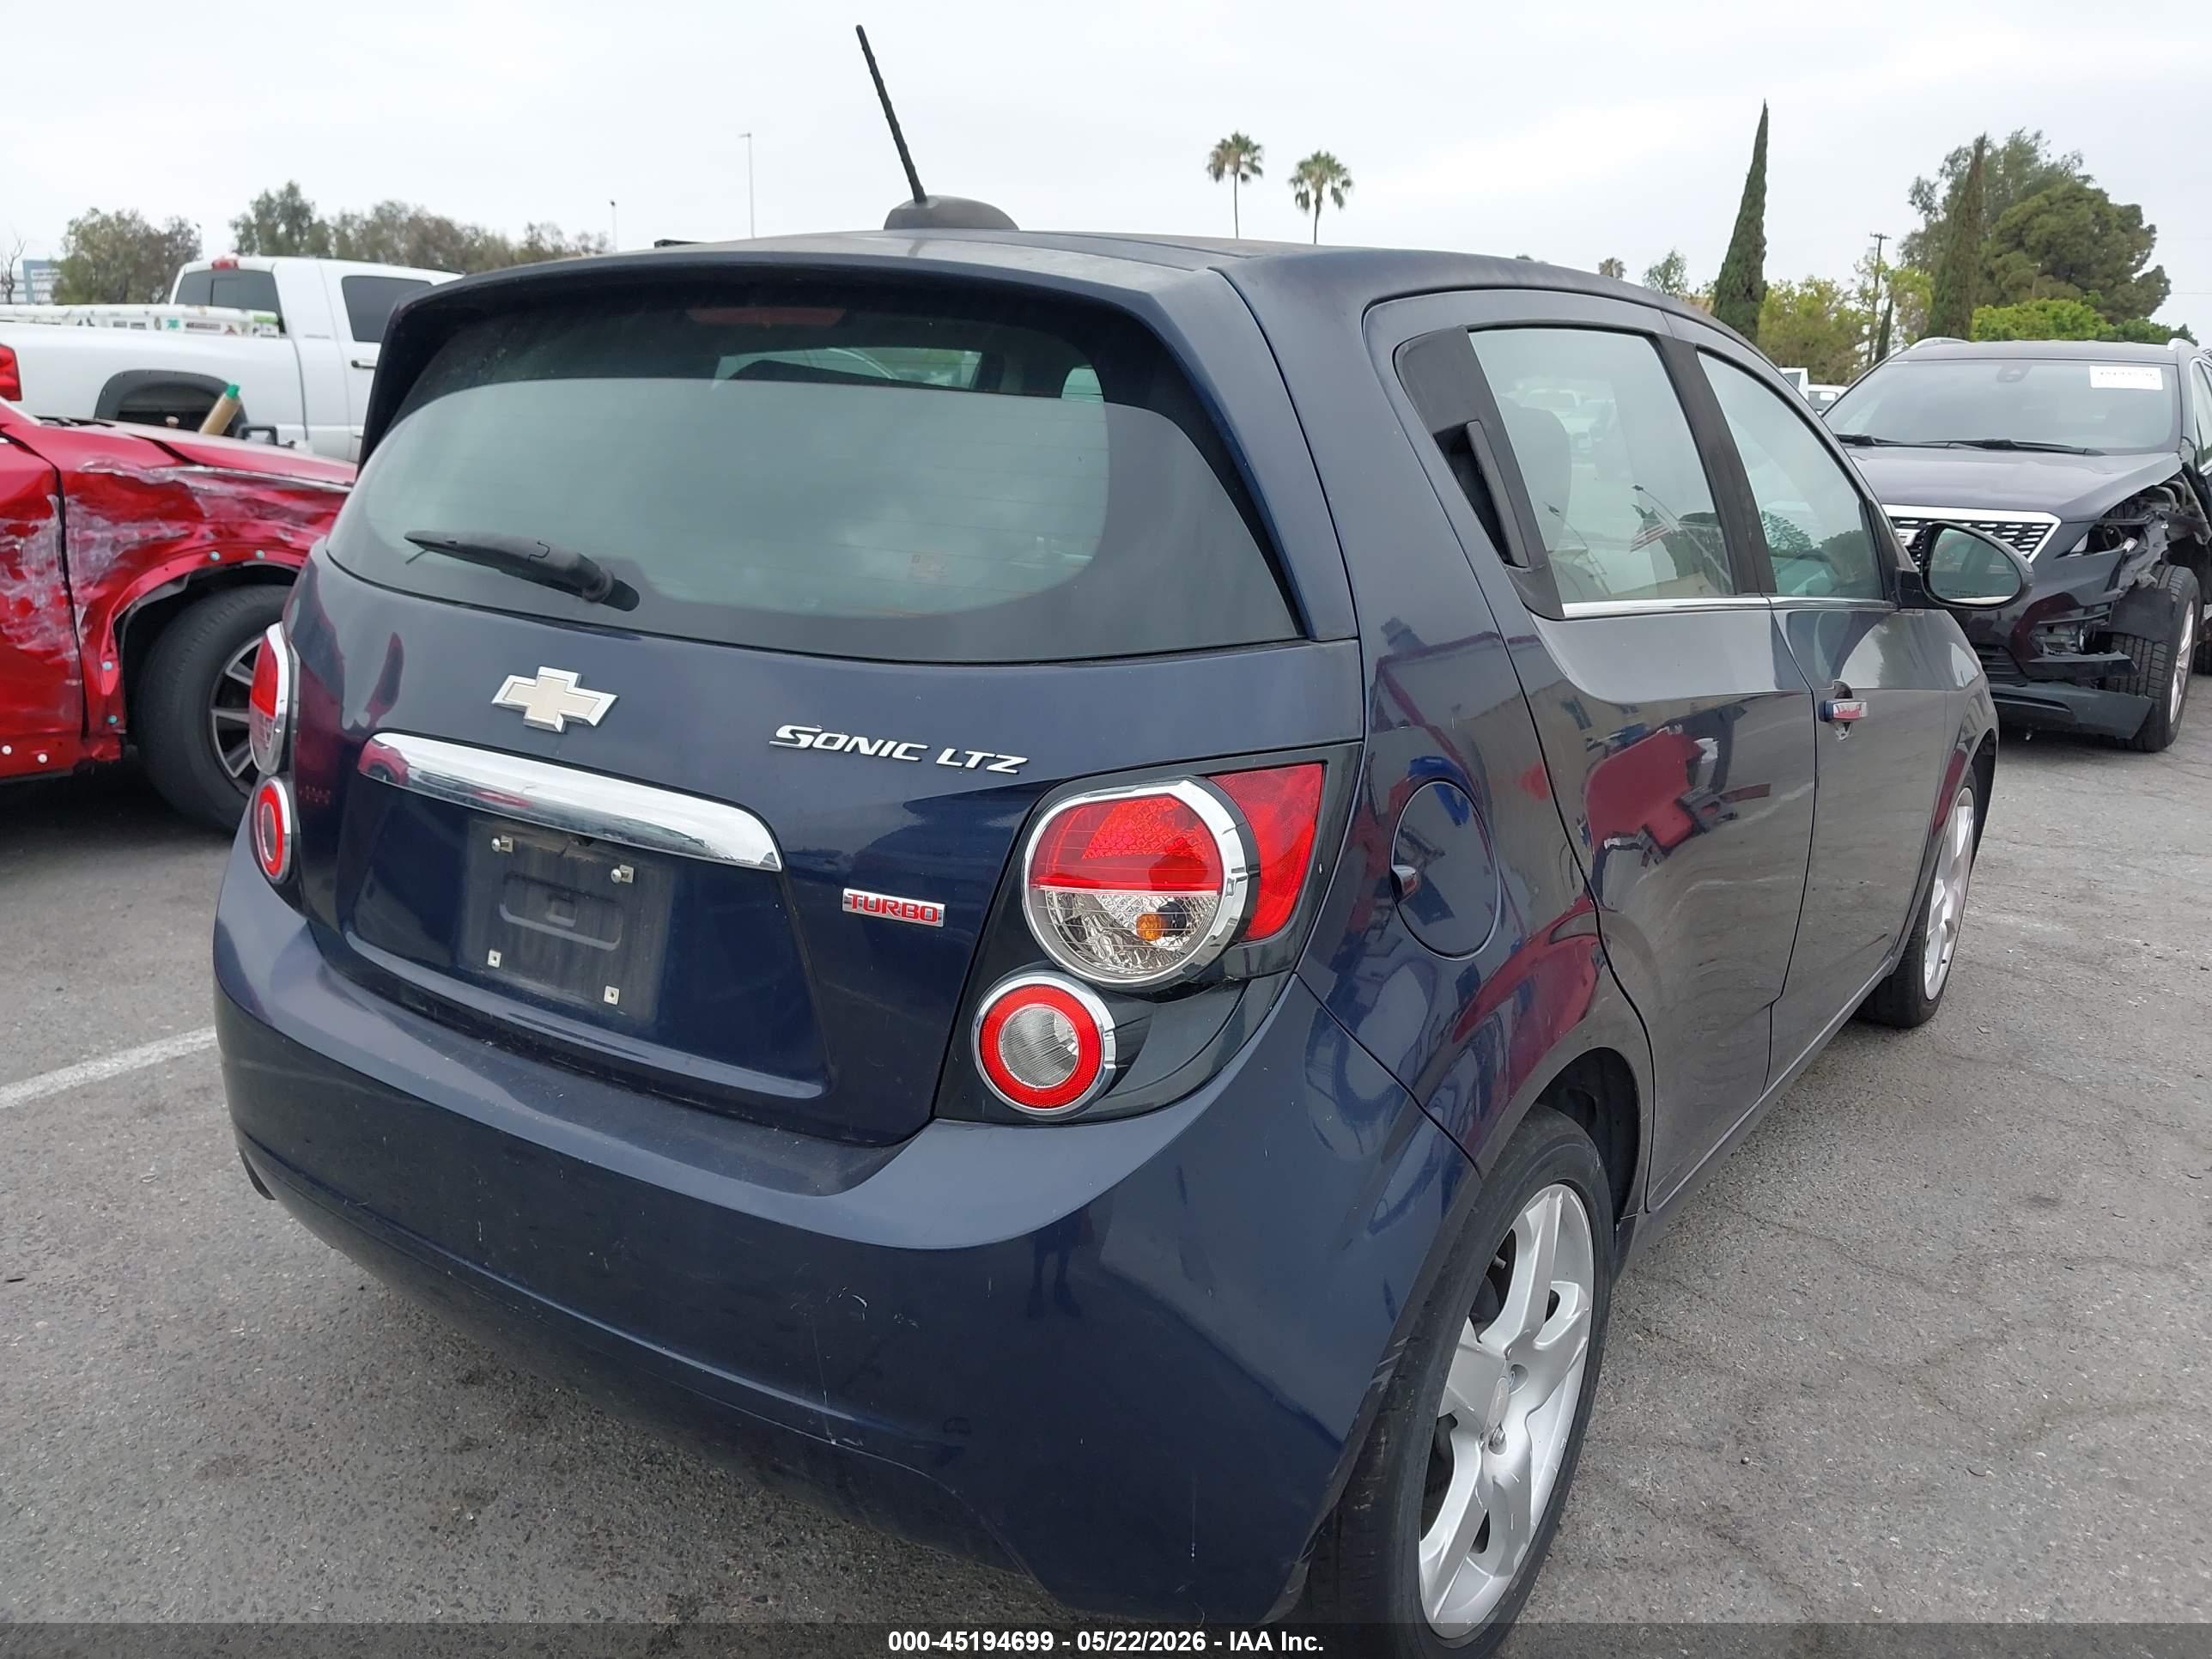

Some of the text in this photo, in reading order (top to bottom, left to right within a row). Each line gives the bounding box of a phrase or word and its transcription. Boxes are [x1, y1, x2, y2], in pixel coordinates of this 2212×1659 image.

[769, 724, 1029, 775] SONIC LTZ
[847, 891, 939, 923] TURBO
